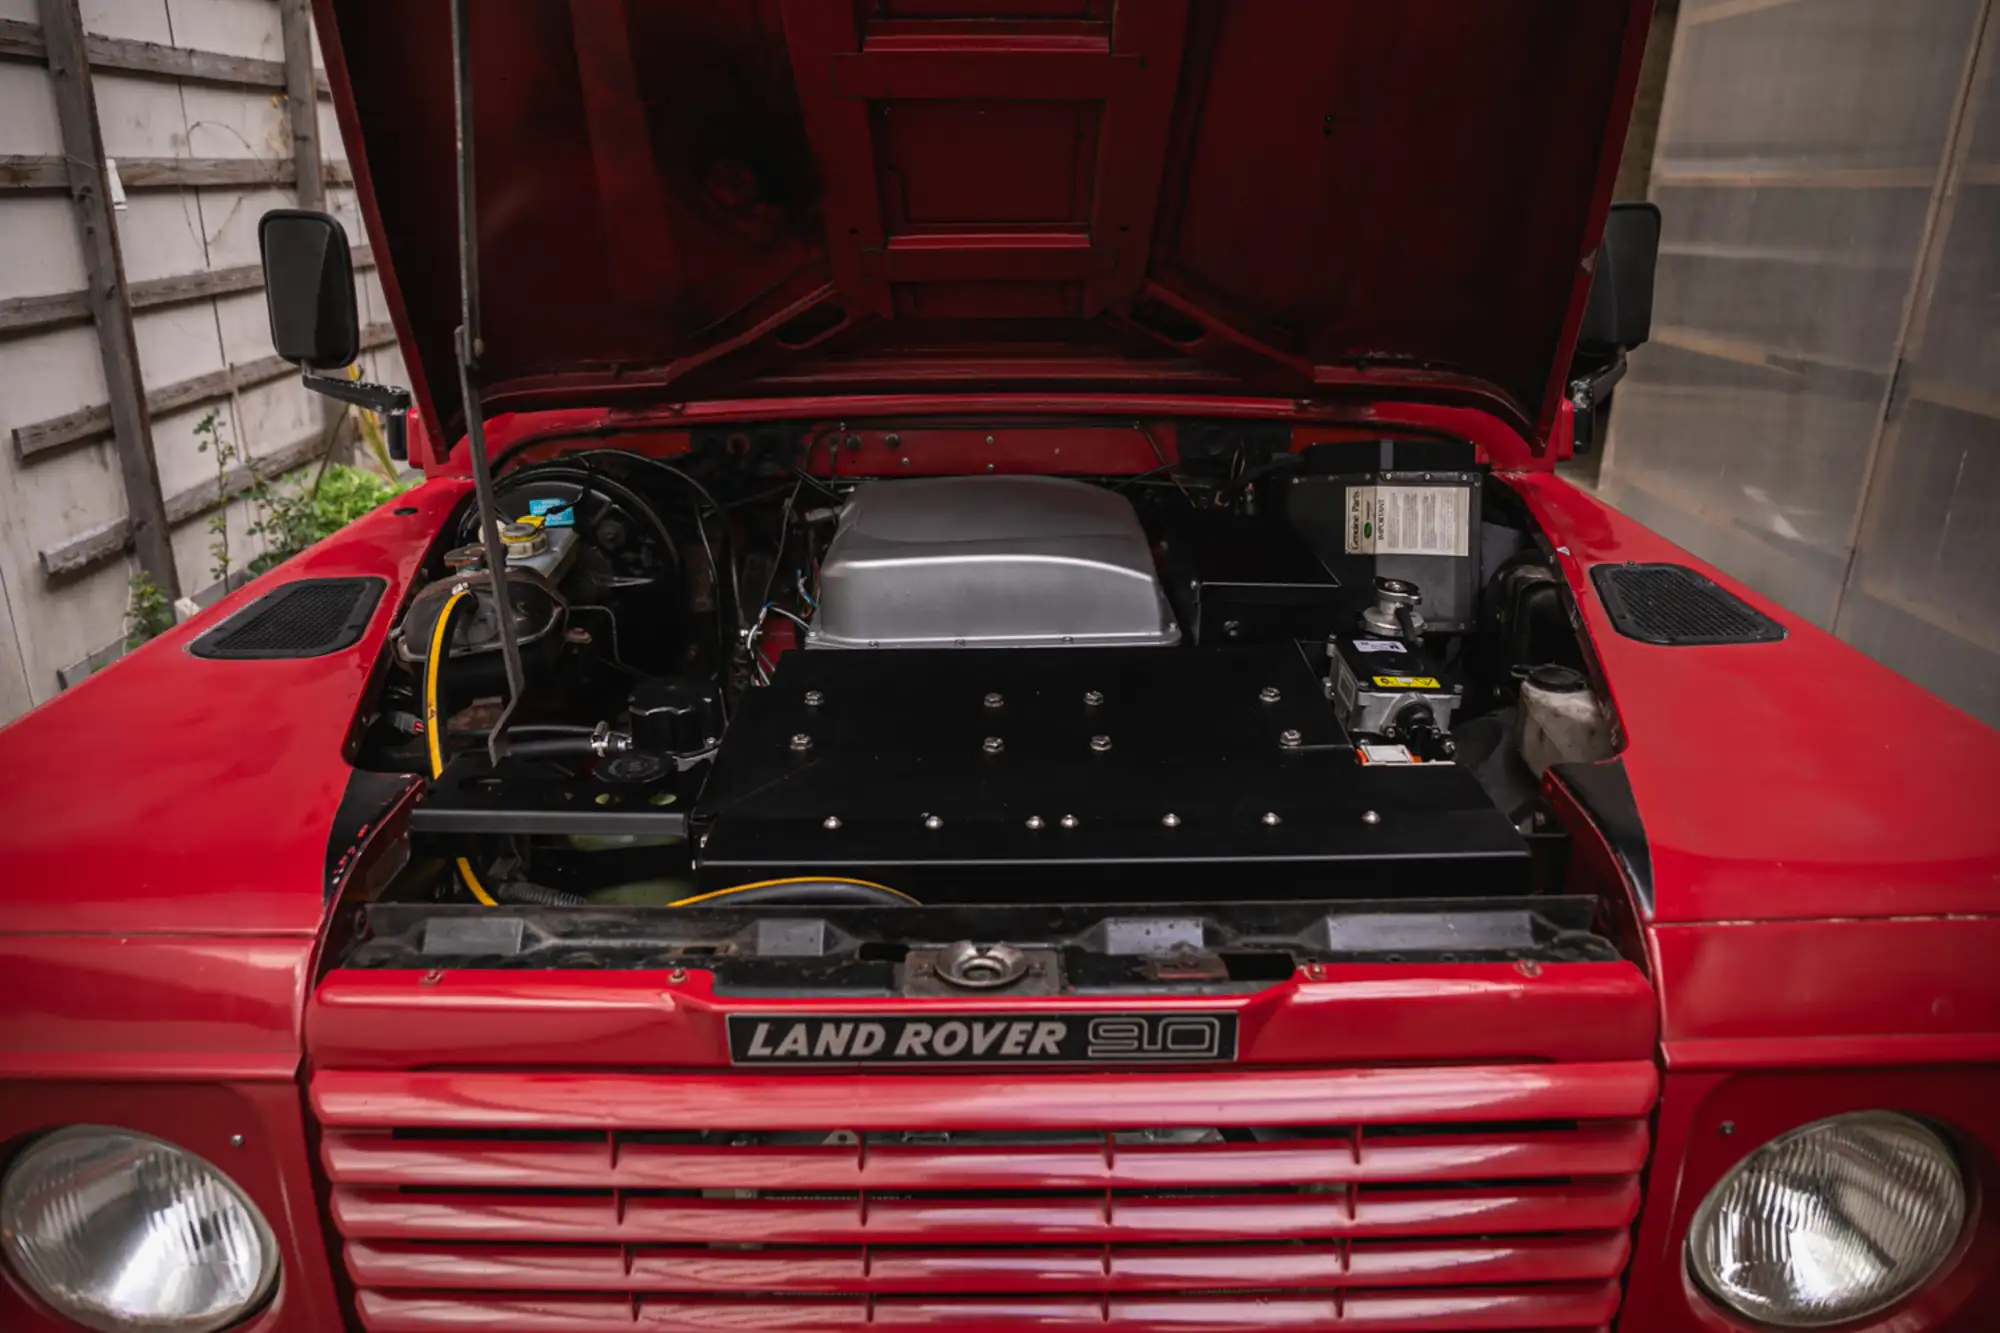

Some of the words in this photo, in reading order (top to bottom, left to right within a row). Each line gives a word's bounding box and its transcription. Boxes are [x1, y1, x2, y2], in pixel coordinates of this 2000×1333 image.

[1351, 490, 1360, 513] Parts
[1351, 514, 1359, 550] Genuine
[747, 1022, 886, 1056] LAND
[894, 1021, 1068, 1056] ROVER
[1088, 1017, 1220, 1057] 90
